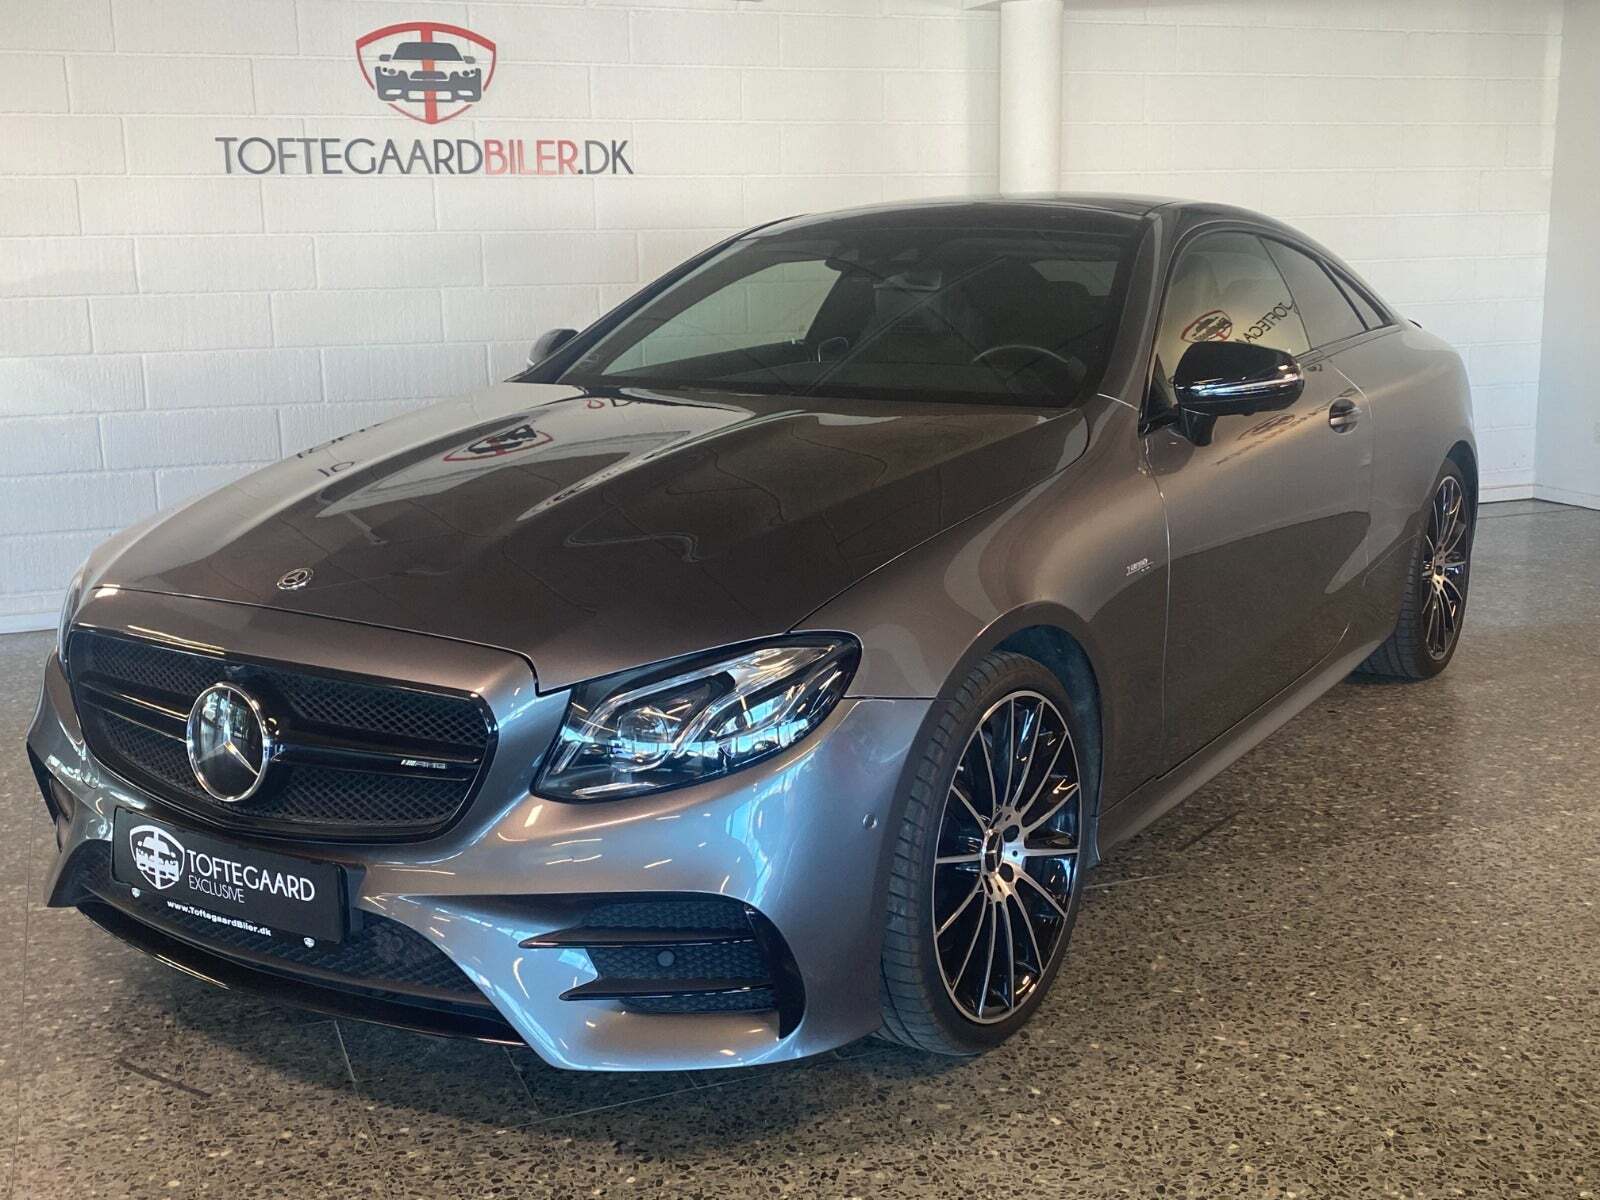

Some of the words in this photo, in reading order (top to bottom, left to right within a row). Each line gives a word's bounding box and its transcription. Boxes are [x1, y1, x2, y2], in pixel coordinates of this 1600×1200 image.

[214, 136, 634, 175] TOFTEGAARDBILER.DK
[186, 849, 315, 901] TOFTEGAARD
[188, 874, 245, 904] EXCLUSIVE
[167, 900, 272, 937] www.ToftegaardBiler.dk
